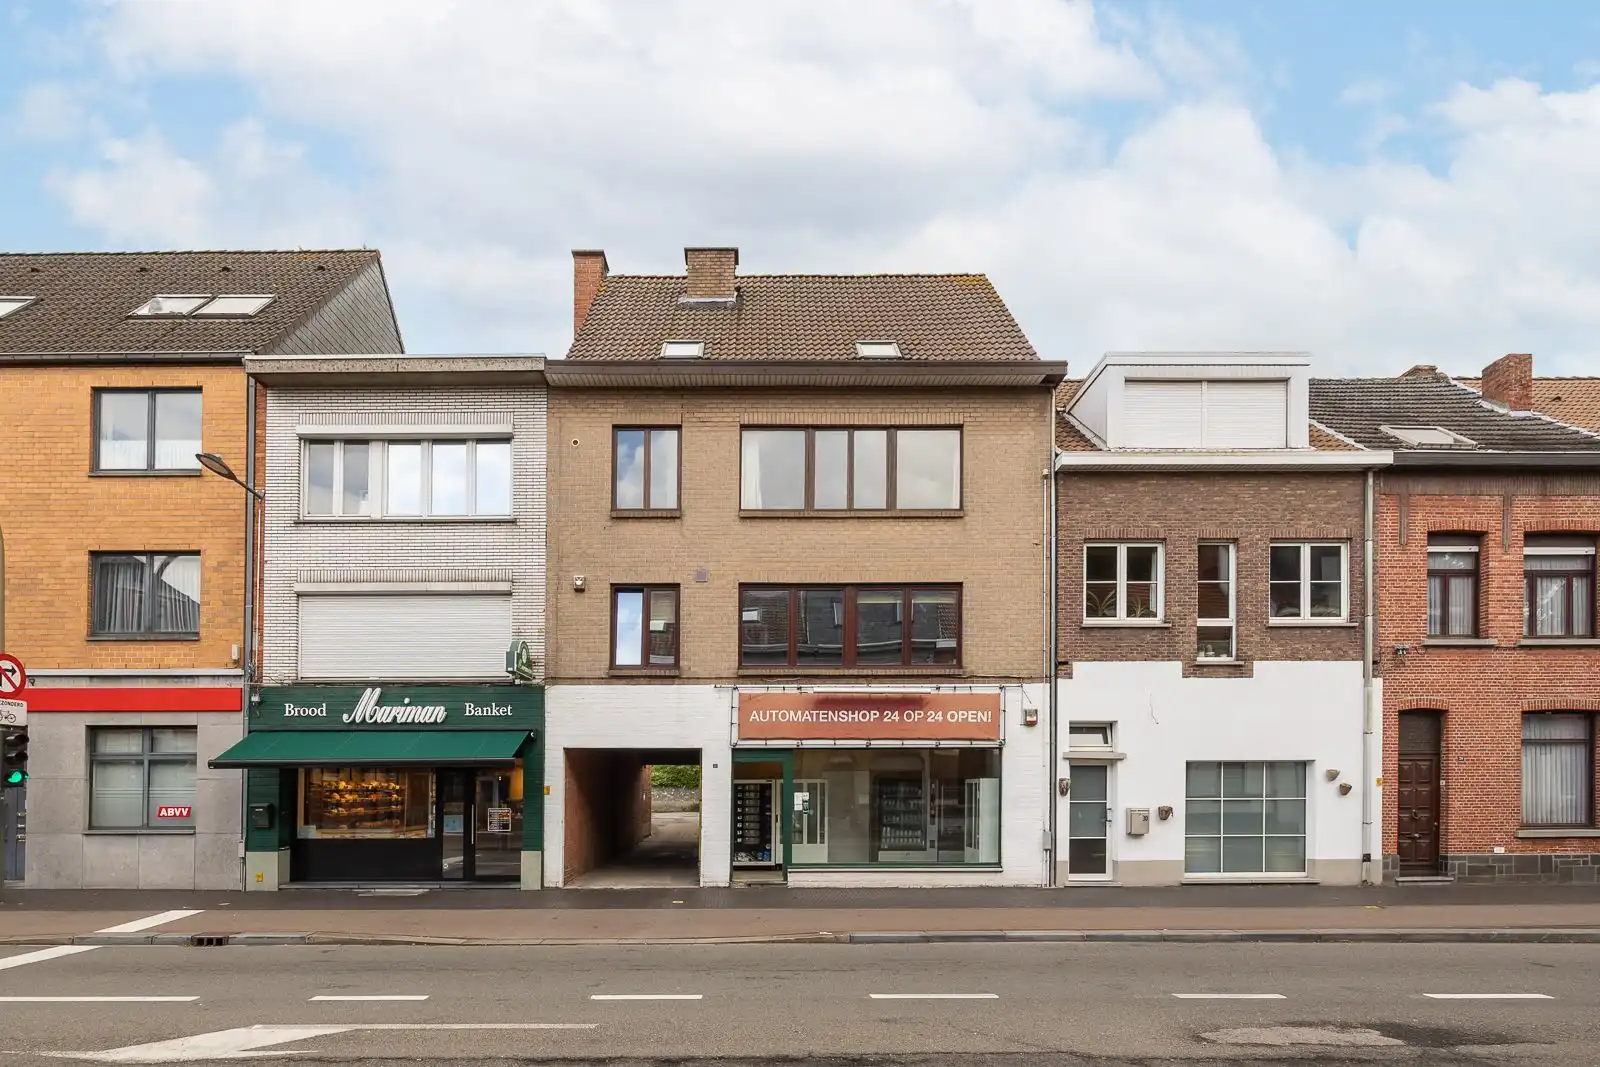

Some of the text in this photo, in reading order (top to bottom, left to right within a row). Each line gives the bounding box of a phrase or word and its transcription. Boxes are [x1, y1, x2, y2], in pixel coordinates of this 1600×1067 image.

[0, 700, 24, 708] ZONDERD
[284, 687, 513, 723] Brood Mariman Banket
[749, 709, 993, 723] AUTOMATENSHOP 24 OP 24 OPEN!
[159, 807, 189, 817] ABVV
